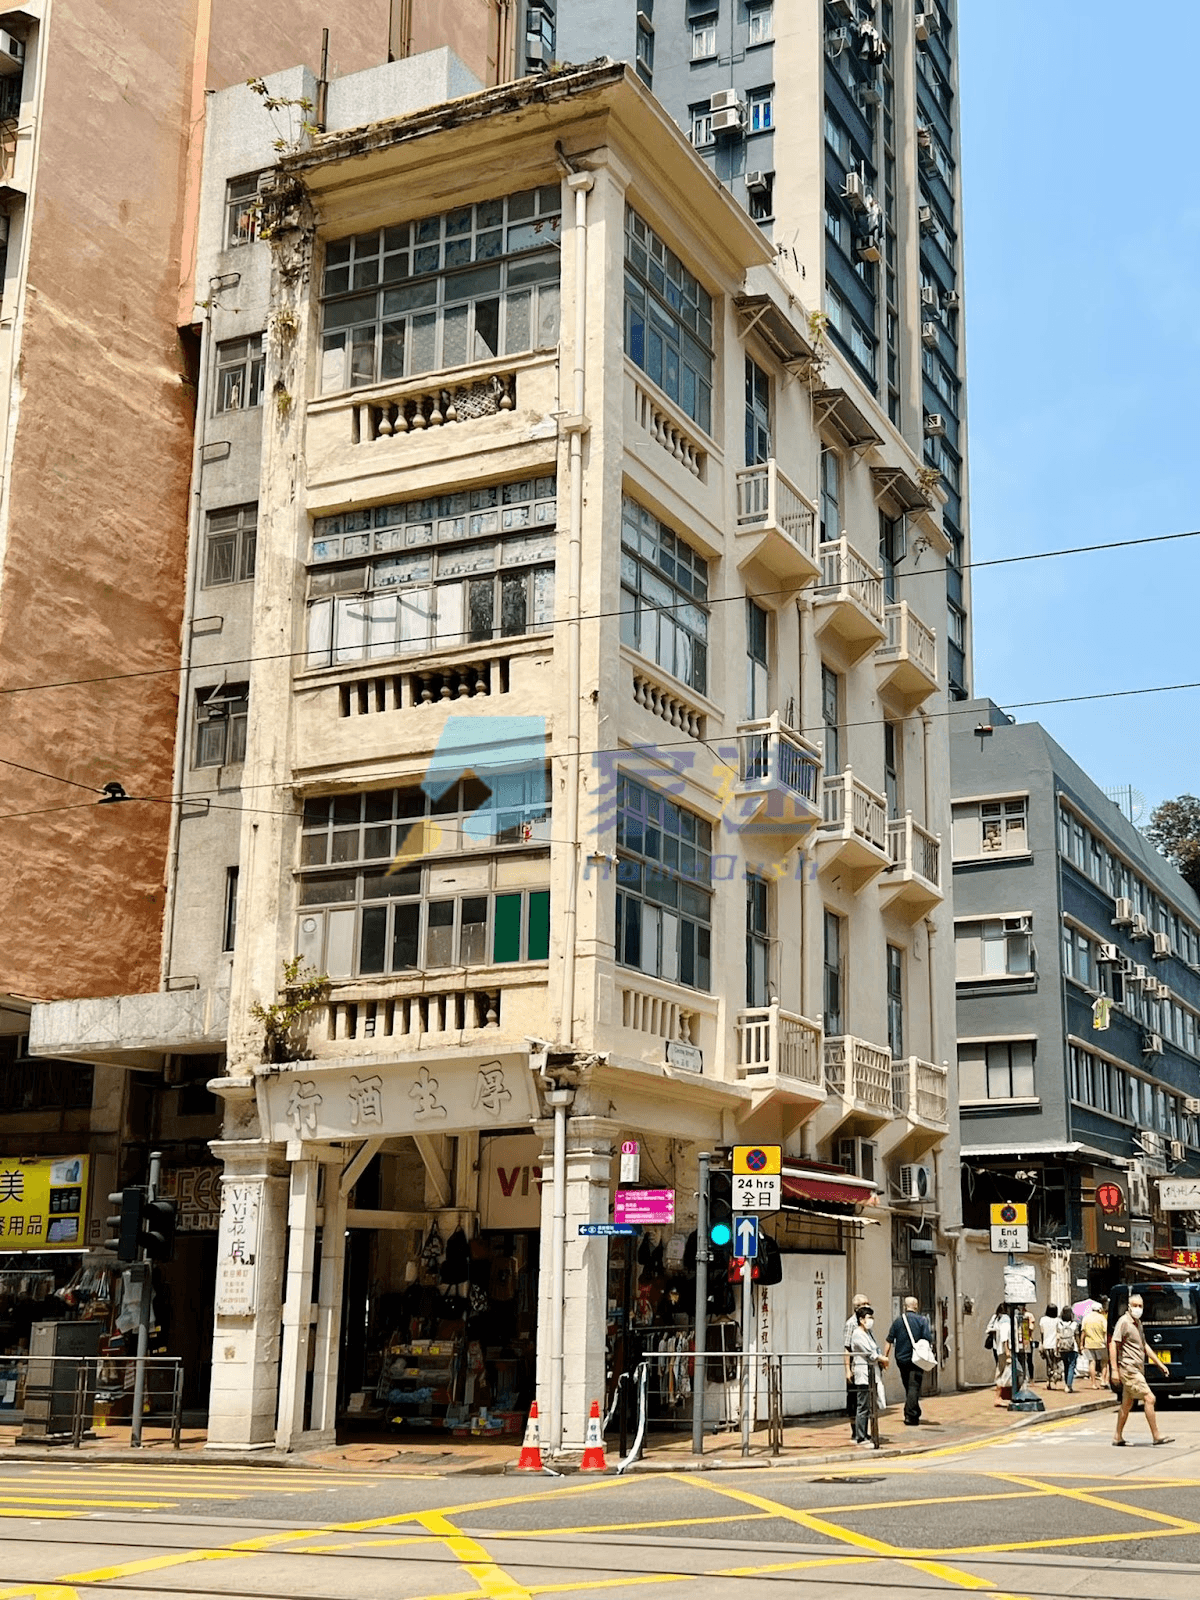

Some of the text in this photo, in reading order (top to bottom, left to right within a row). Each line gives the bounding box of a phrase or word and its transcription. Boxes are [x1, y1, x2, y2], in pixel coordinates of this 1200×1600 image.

[0, 1169, 25, 1204] 美
[737, 1178, 775, 1189] 24 hrs
[742, 1191, 771, 1207] 全日
[0, 1214, 42, 1236] 用品
[1001, 1228, 1018, 1236] End
[998, 1238, 1021, 1249] 終止
